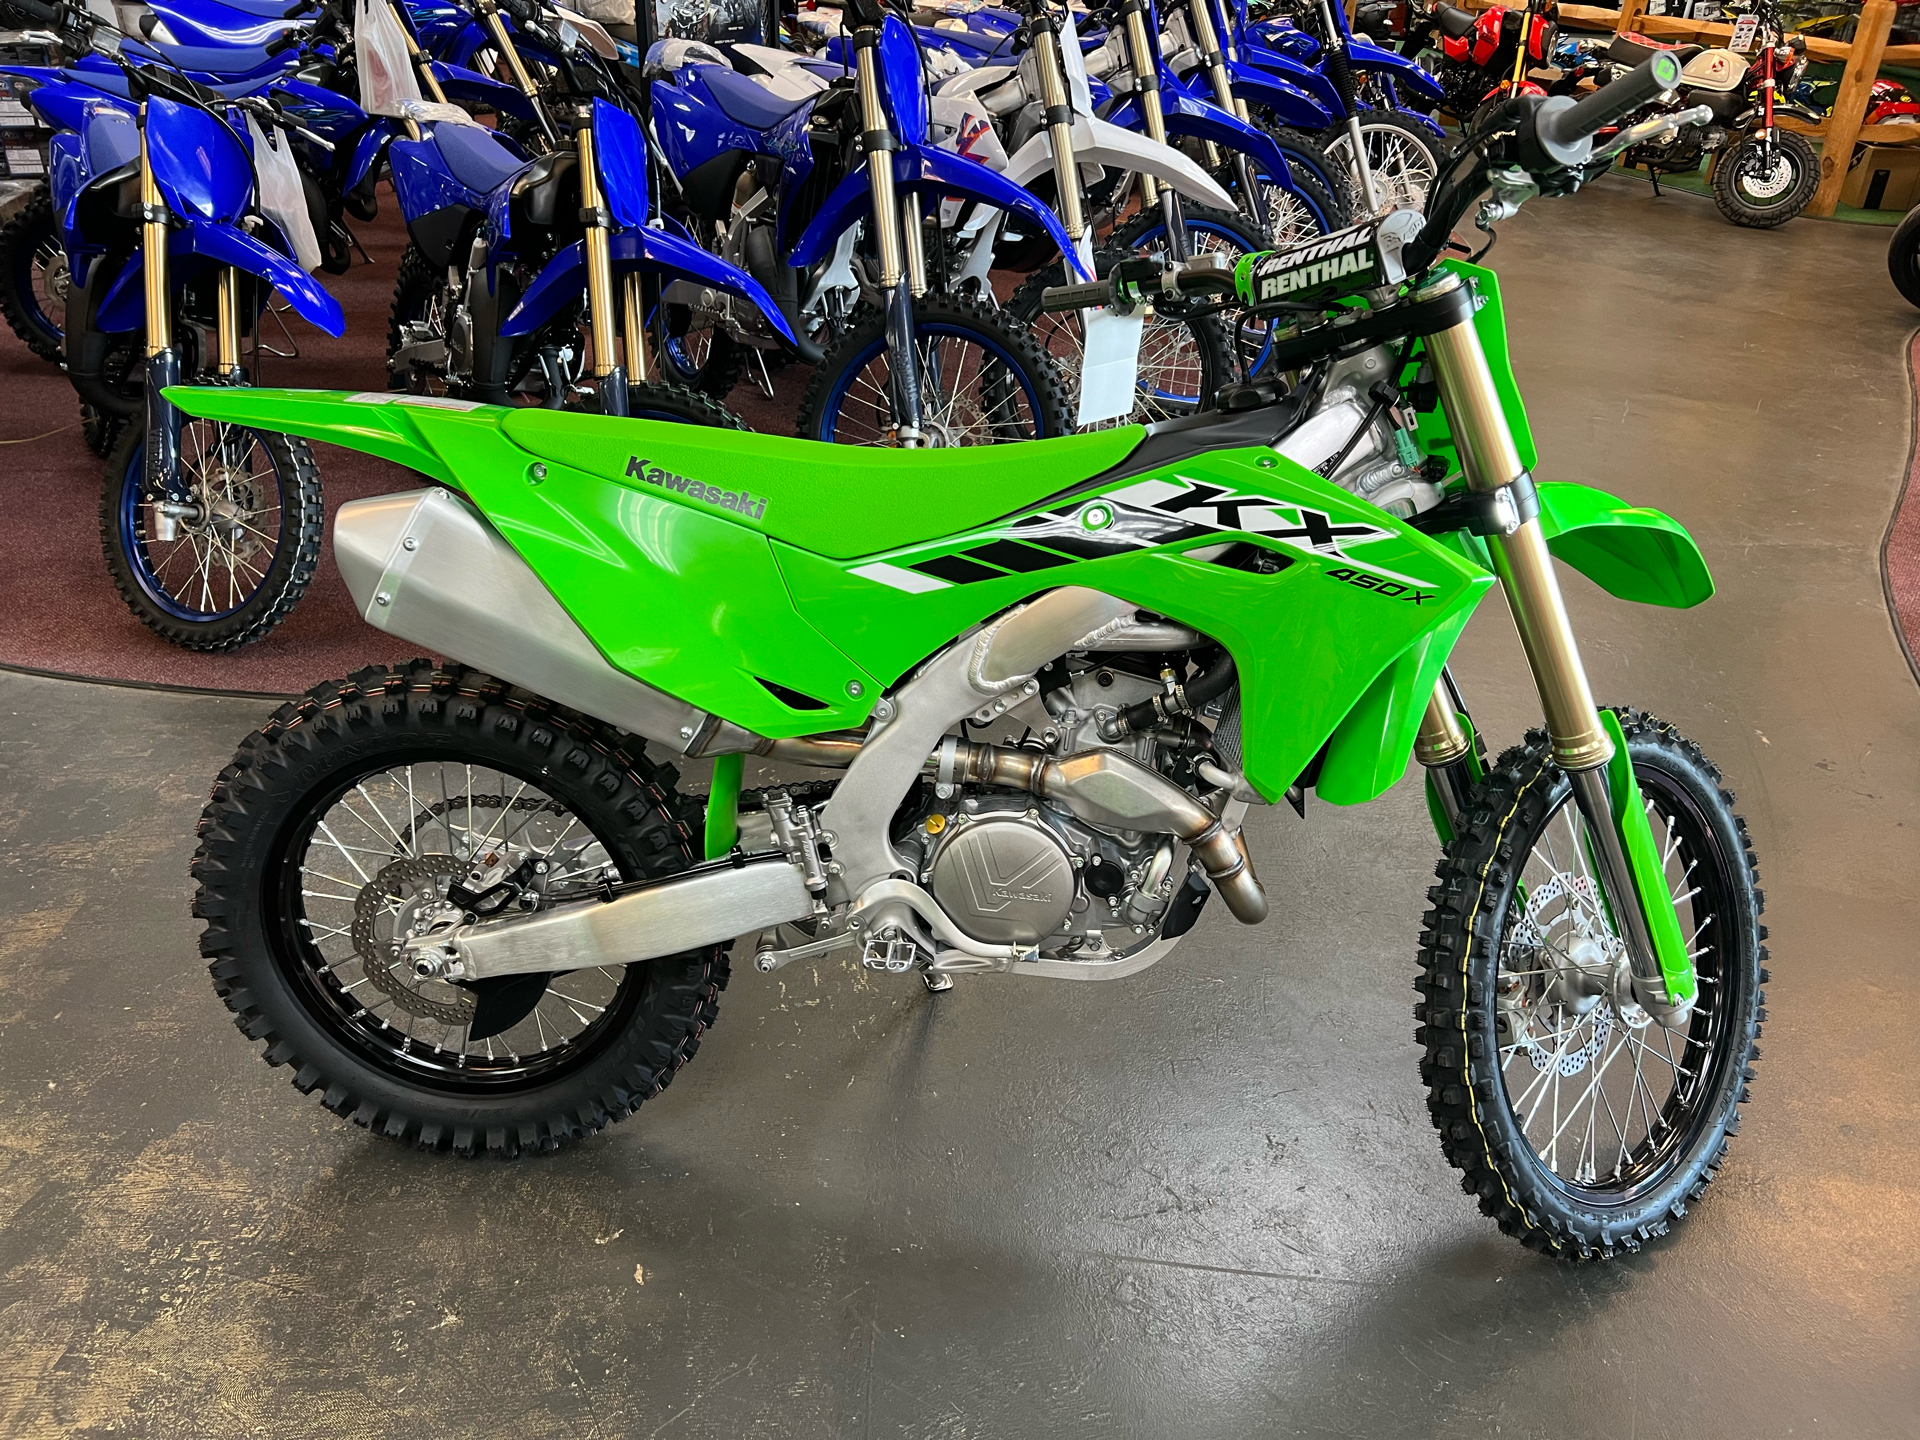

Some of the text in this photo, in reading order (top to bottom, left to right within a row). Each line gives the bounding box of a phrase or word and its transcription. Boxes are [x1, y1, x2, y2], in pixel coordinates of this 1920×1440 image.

[1257, 226, 1371, 278] RENTHAL
[1261, 249, 1374, 300] RENTHAL
[625, 455, 768, 520] Kawasaki
[1150, 481, 1381, 560] KX
[991, 887, 1053, 903] Kawasaki
